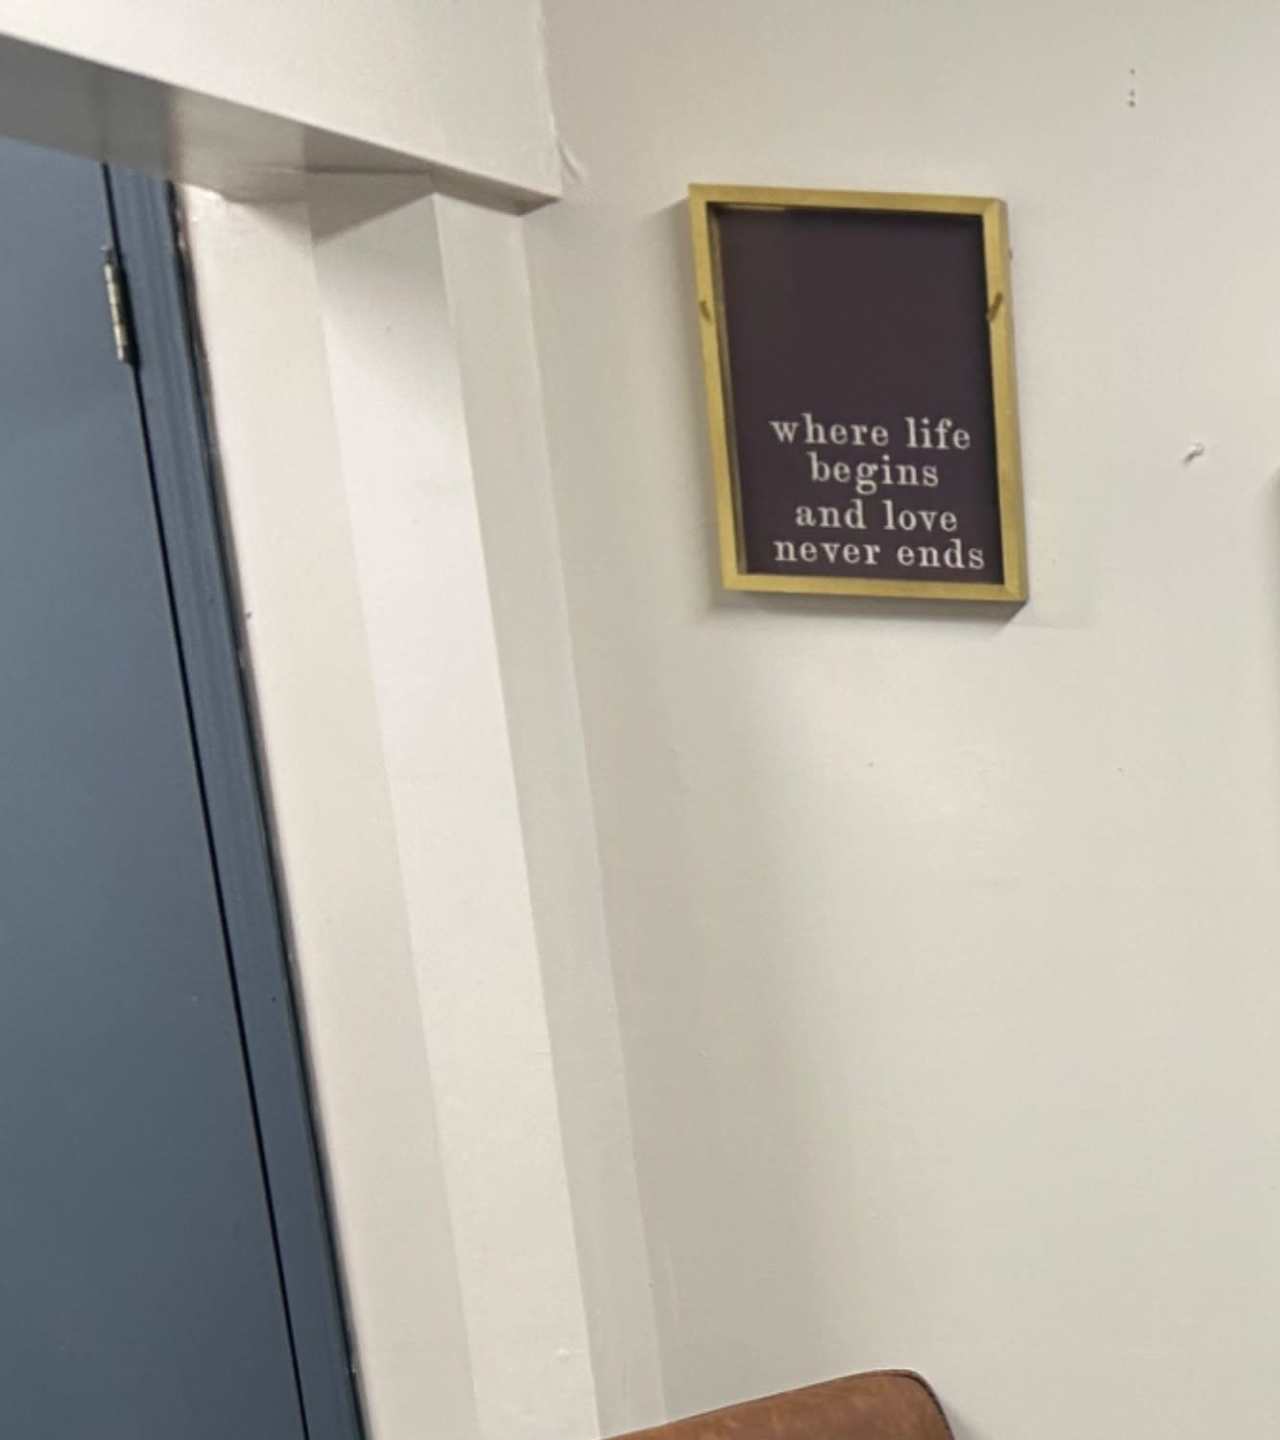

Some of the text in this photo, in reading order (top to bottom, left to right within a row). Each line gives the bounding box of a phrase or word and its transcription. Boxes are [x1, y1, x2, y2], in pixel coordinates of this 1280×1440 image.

[769, 412, 971, 451] where life
[809, 451, 940, 495] begins
[795, 499, 958, 532] and love
[773, 538, 985, 570] never ends
